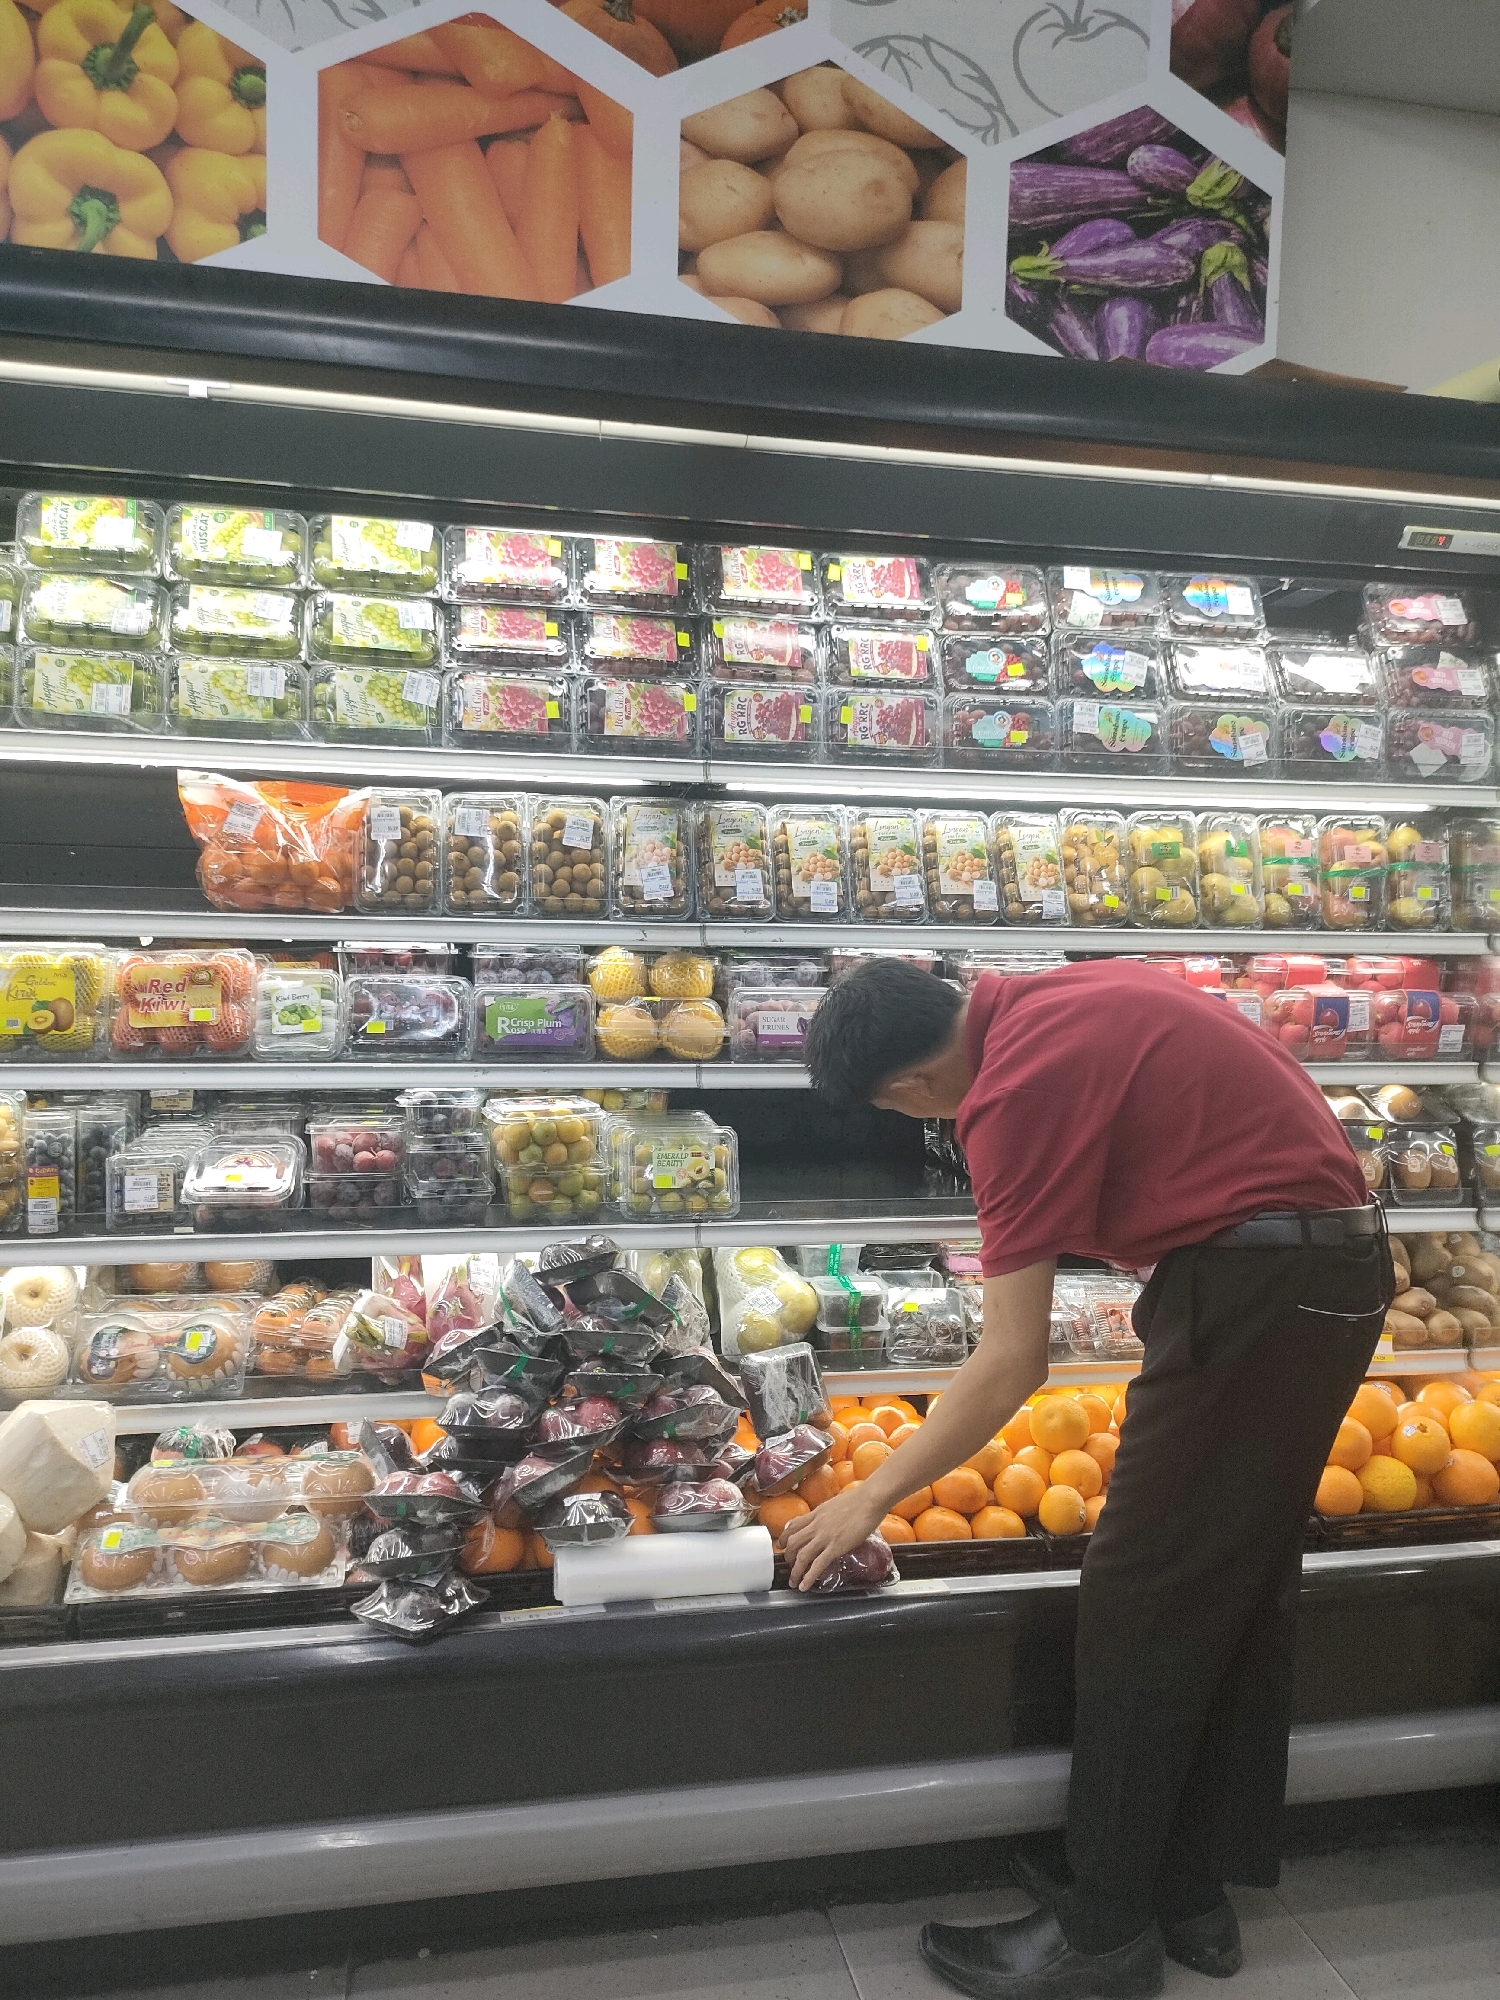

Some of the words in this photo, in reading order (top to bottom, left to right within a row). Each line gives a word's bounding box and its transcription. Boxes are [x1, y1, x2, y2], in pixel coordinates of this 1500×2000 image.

[60, 501, 71, 541] MUSCAT
[202, 511, 210, 553] MUSCAT
[733, 551, 741, 574] Globe
[853, 563, 862, 581] RRC
[734, 575, 742, 590] Red
[857, 581, 865, 594] RG
[736, 641, 745, 655] RG
[863, 638, 871, 655] RRC
[863, 656, 872, 671] RG
[38, 672, 57, 709] Anggur
[185, 678, 202, 715] Anggur
[615, 684, 625, 708] Globe
[343, 685, 359, 723] Anggur
[739, 696, 748, 717] RRC
[860, 702, 870, 722] RRC
[473, 704, 482, 724] Red
[614, 710, 624, 728] Red
[739, 719, 748, 738] RG
[860, 724, 870, 741] RG
[1108, 711, 1120, 748] Sunshine
[1229, 720, 1239, 757] Sunshine
[1339, 719, 1348, 759] Sunshine
[716, 814, 745, 826] Longan
[873, 821, 900, 833] Longan
[794, 827, 821, 839] Longan
[942, 824, 969, 835] Longan
[1017, 830, 1041, 842] Longan
[18, 974, 57, 987] Golden
[147, 977, 188, 994] Red
[6, 983, 38, 1002] Kiwi
[292, 993, 310, 1001] Berry
[139, 995, 187, 1013] Kiwi
[497, 1016, 527, 1035] Rose
[511, 1018, 535, 1028] Crisp
[537, 1018, 562, 1027] Plum
[656, 1152, 689, 1160] EMERALD
